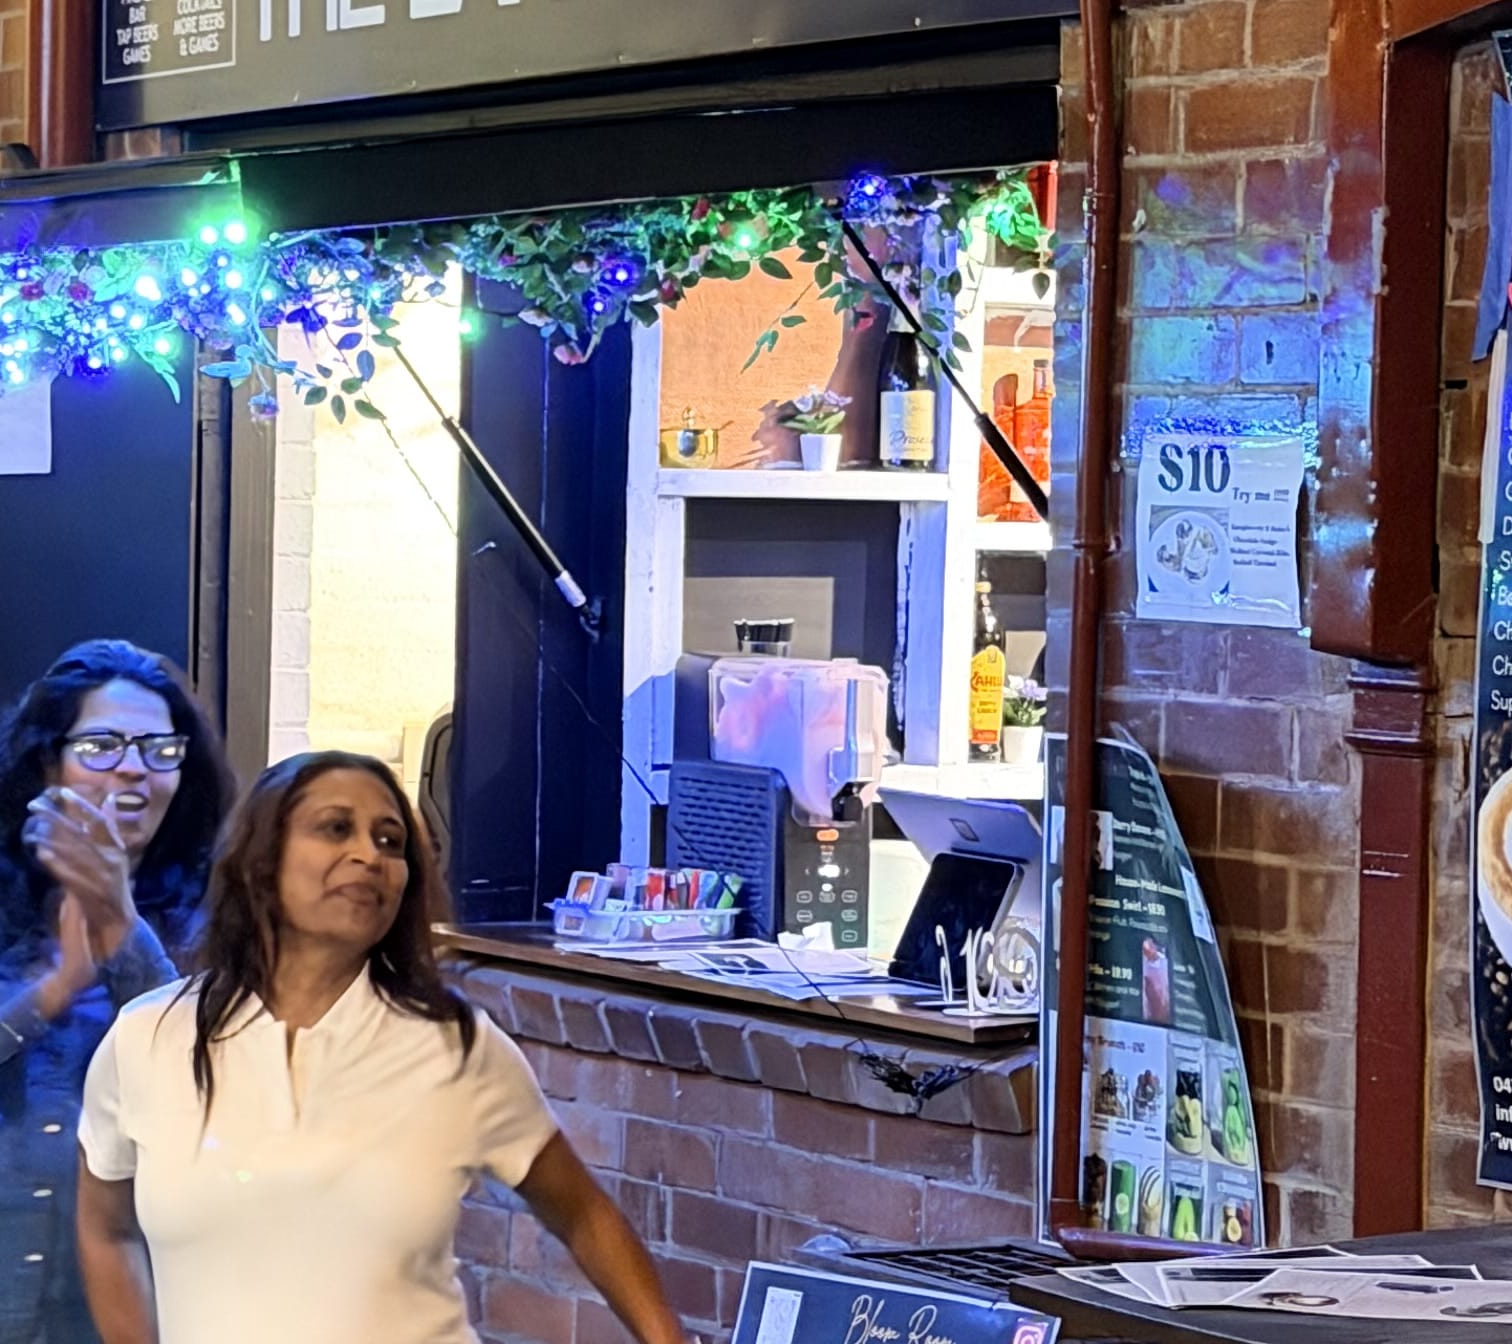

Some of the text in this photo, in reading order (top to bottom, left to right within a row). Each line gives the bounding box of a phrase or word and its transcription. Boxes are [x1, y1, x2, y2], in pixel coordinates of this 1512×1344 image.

[129, 6, 146, 24] BAR
[173, 11, 225, 35] MORE BEERS
[116, 24, 159, 46] TAP BEERS
[189, 32, 219, 55] GAMES
[123, 44, 151, 65] GAMES
[1158, 443, 1230, 493] $10
[1232, 487, 1250, 504] Try
